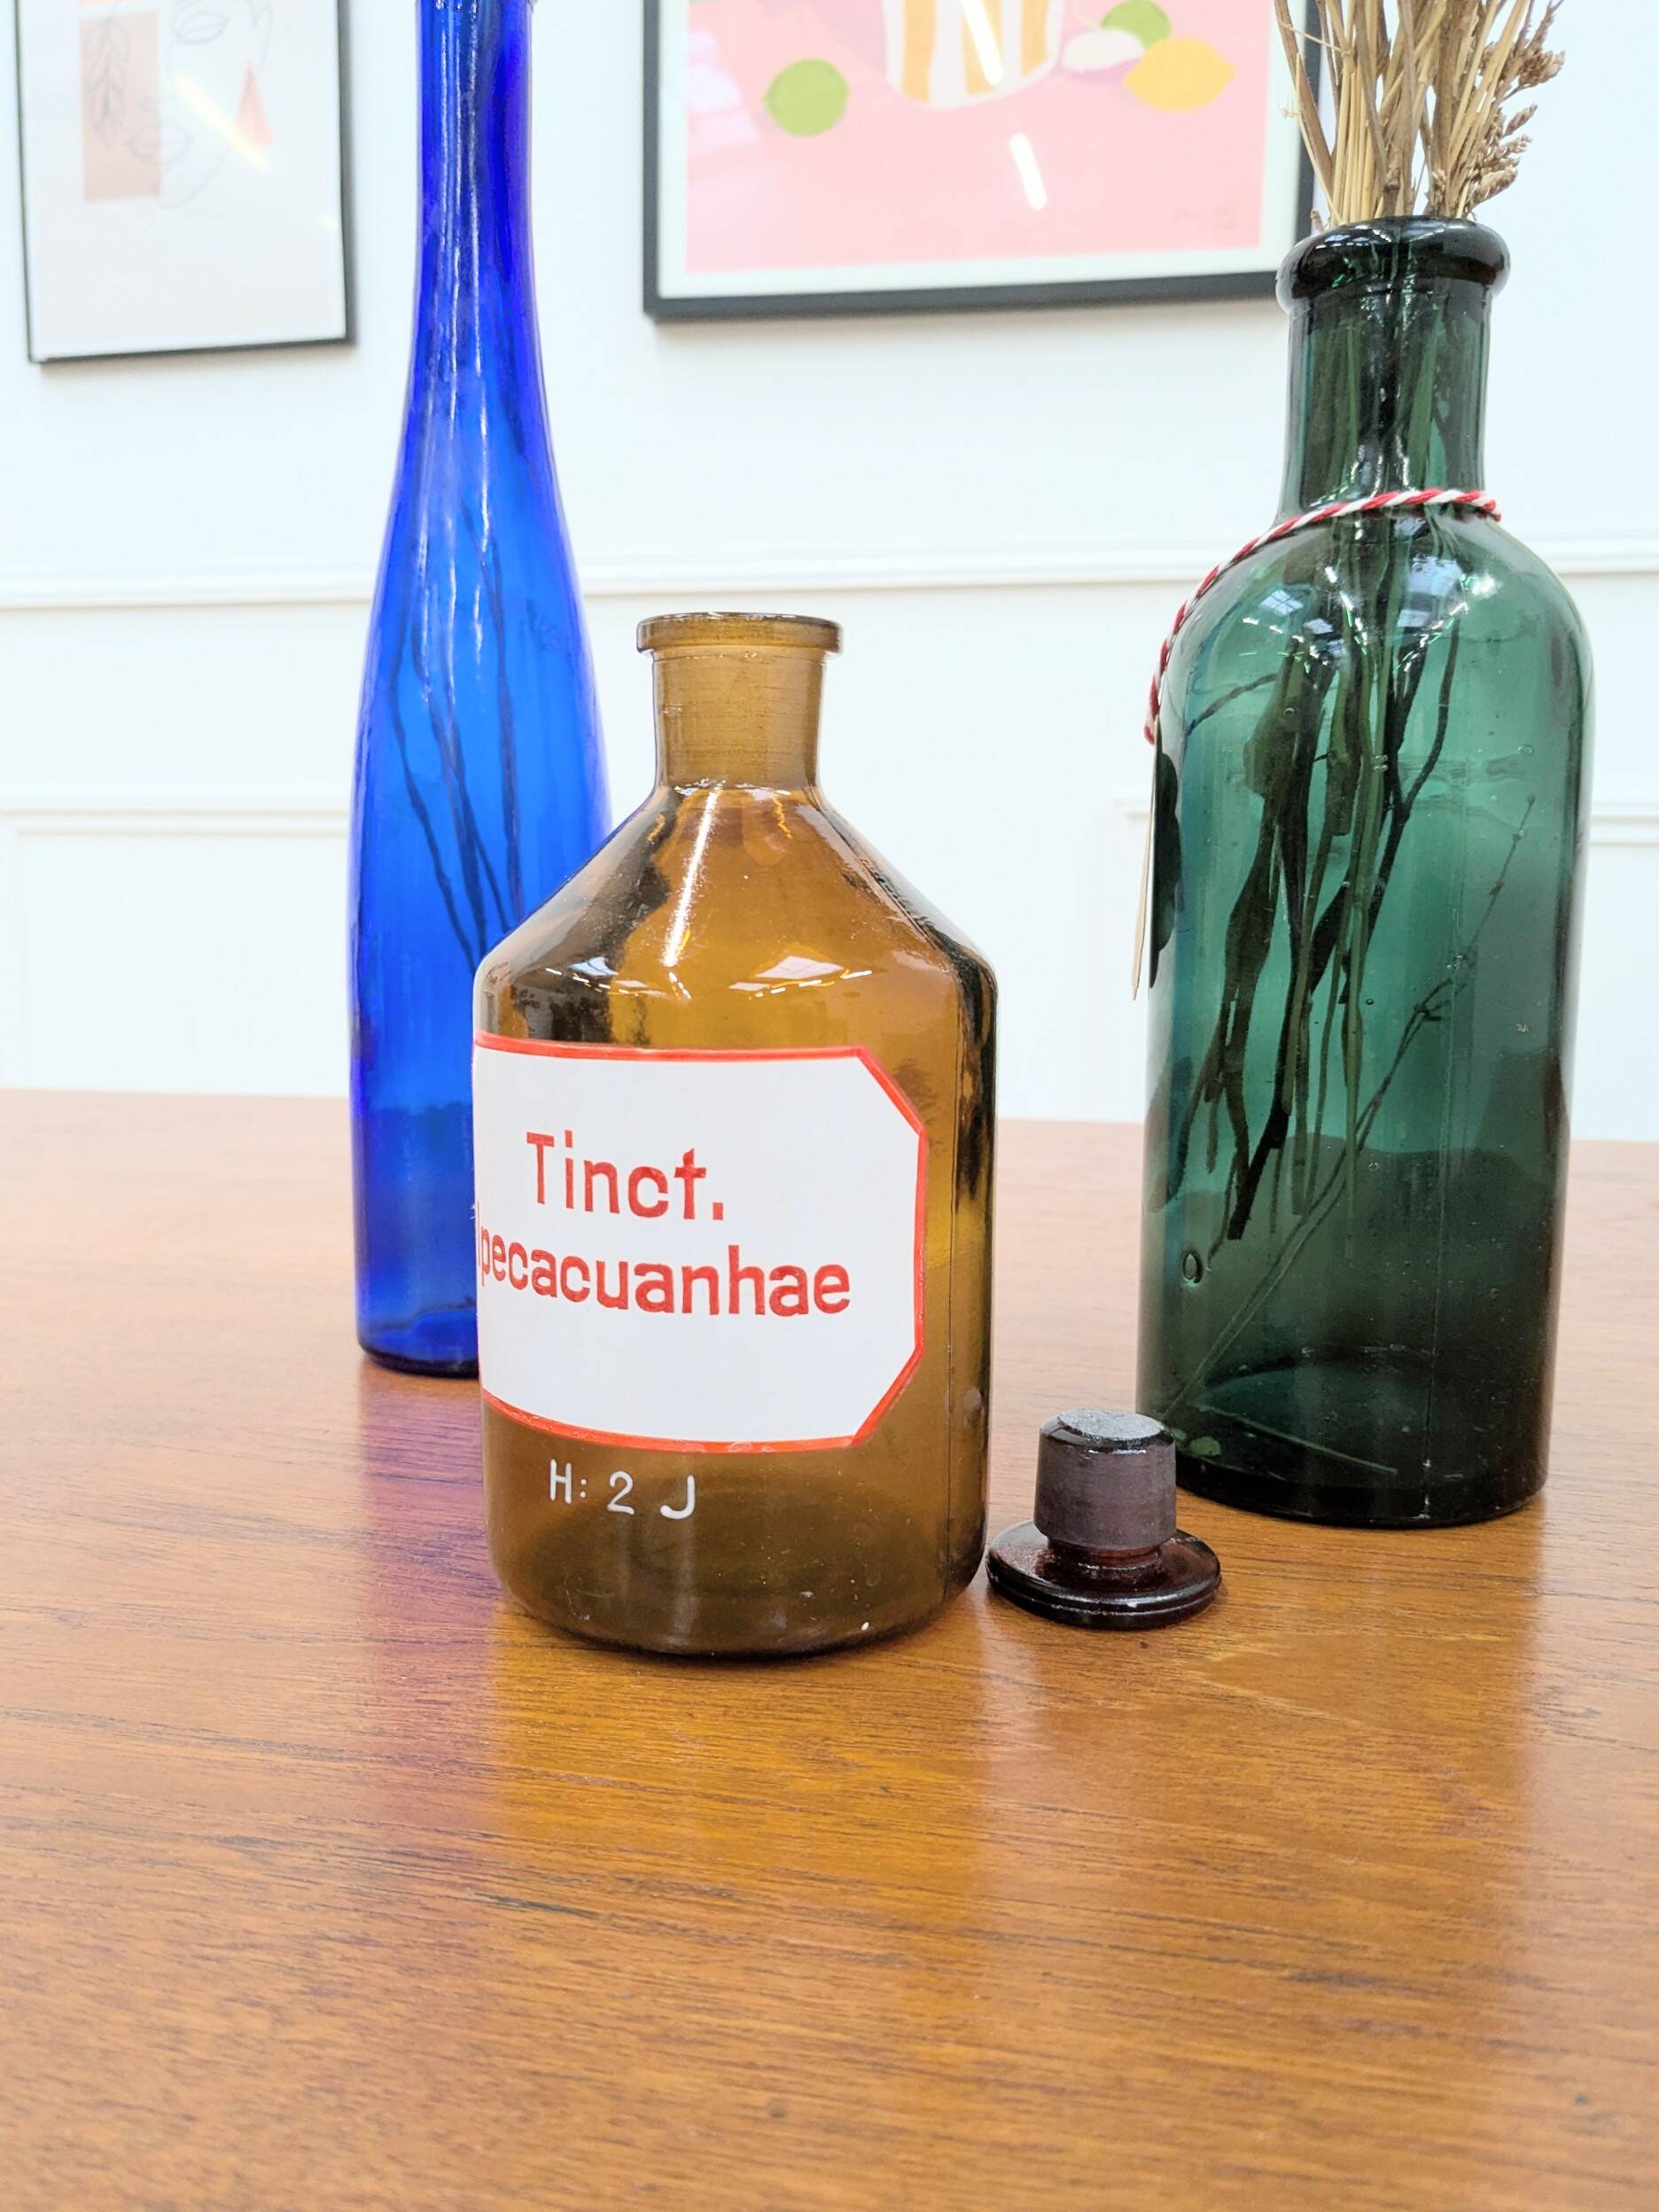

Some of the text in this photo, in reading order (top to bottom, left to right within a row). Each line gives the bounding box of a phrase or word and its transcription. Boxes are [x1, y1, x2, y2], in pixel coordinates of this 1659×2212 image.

[526, 1130, 724, 1220] Tinct.
[549, 1460, 696, 1519] H: 2 J
